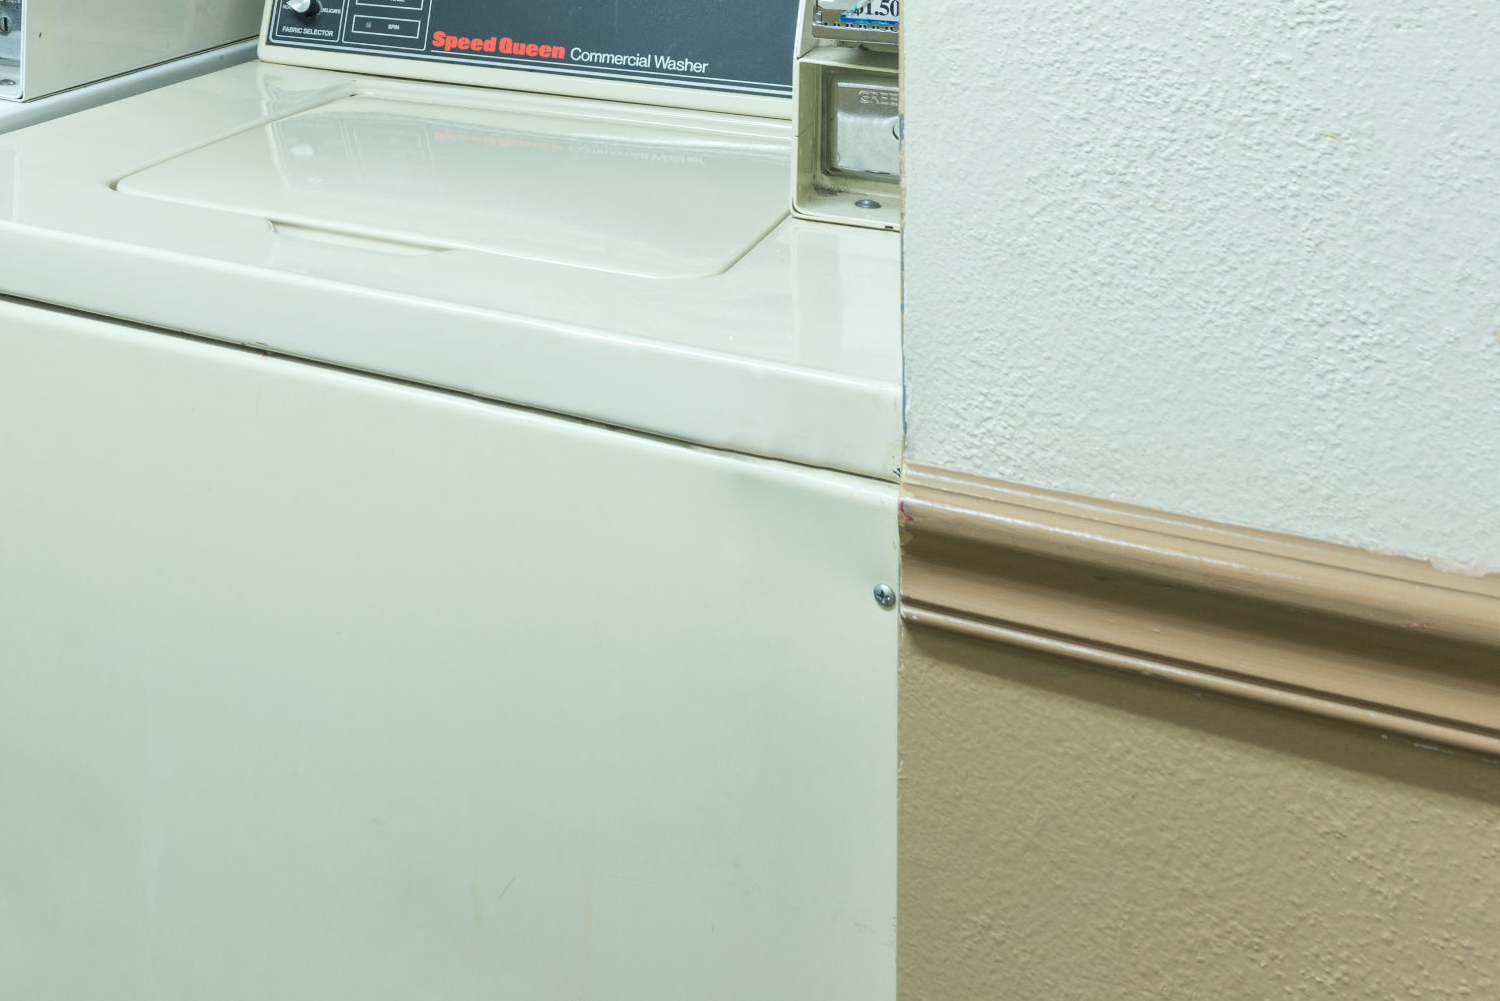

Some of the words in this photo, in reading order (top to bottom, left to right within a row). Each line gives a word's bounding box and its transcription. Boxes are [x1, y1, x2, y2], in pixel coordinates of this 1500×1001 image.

[282, 26, 303, 34] FABRIC
[303, 27, 334, 36] SELECTOR
[432, 30, 498, 53] Speed
[498, 37, 566, 59] Queen
[570, 47, 651, 67] Commercial
[654, 54, 709, 73] Washer
